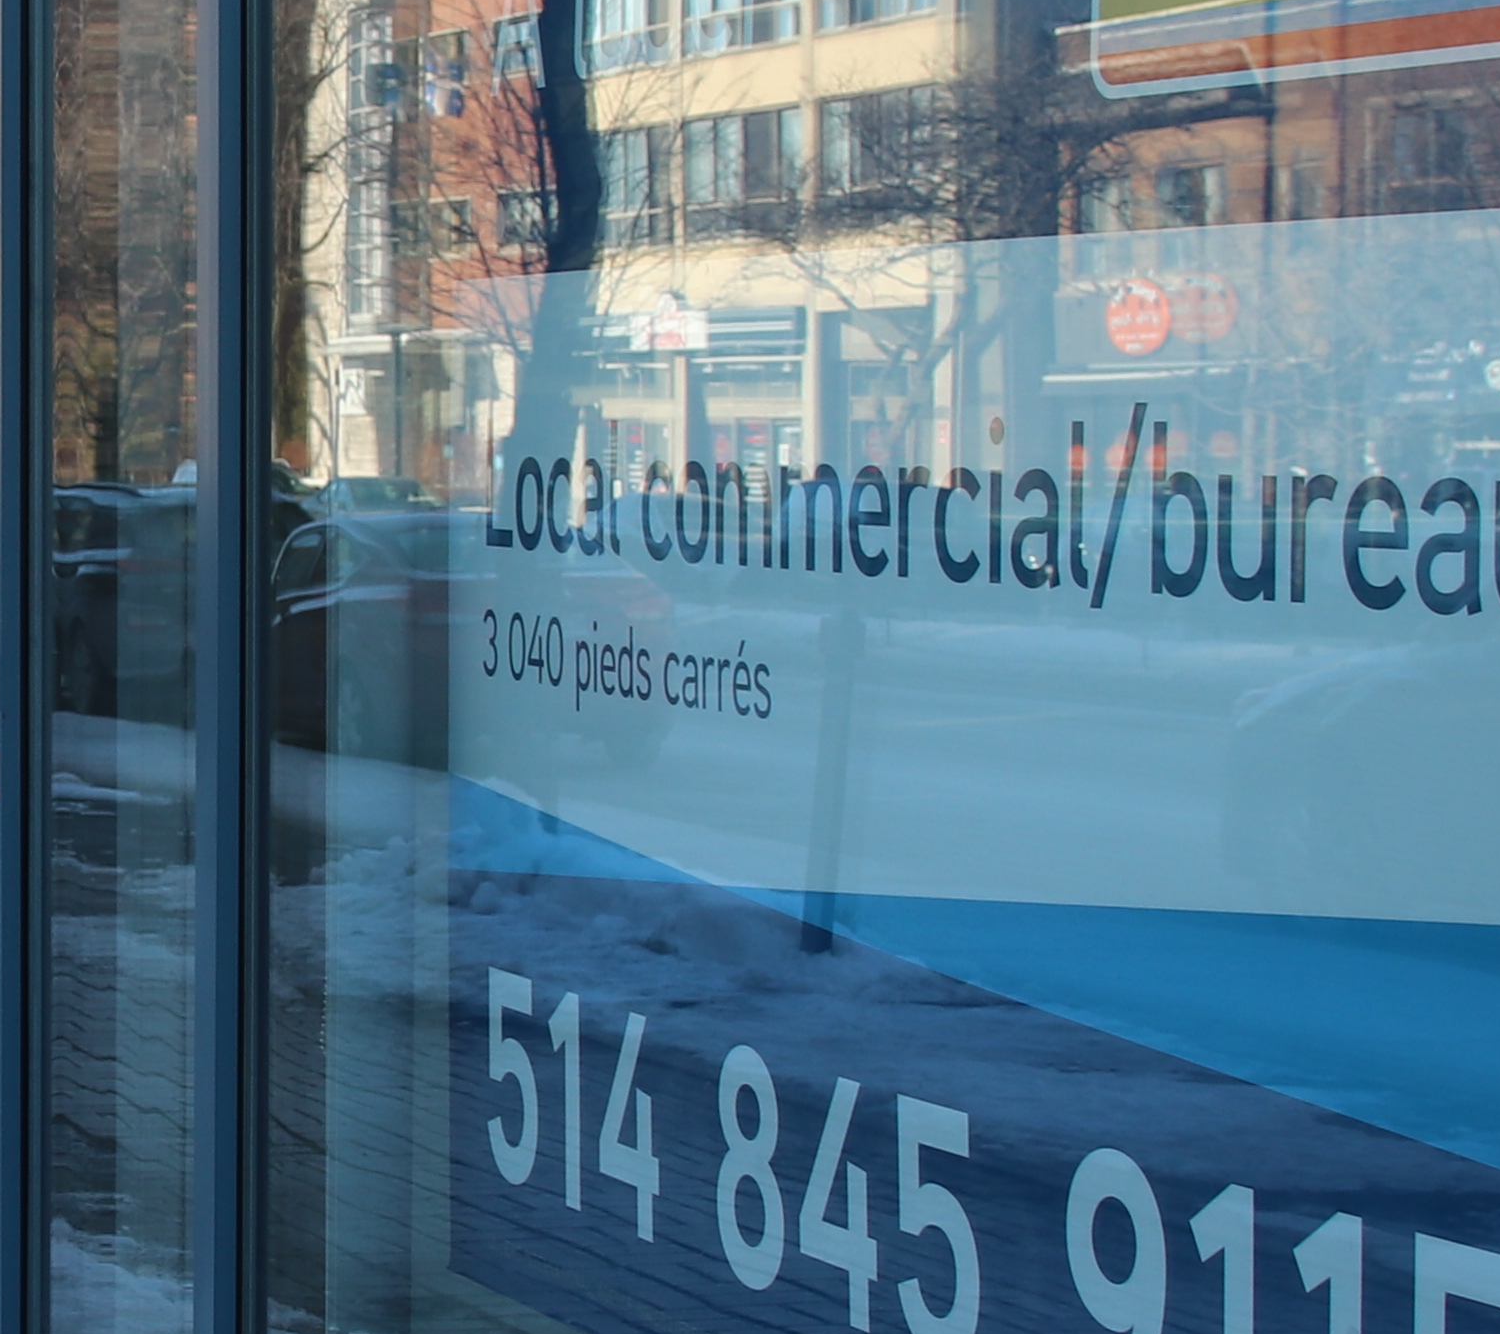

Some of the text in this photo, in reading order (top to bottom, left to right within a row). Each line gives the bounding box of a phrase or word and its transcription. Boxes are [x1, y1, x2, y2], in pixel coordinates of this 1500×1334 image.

[484, 417, 623, 559] Local
[481, 608, 772, 720] 3 040 pieds carrés
[486, 965, 662, 1244] 514
